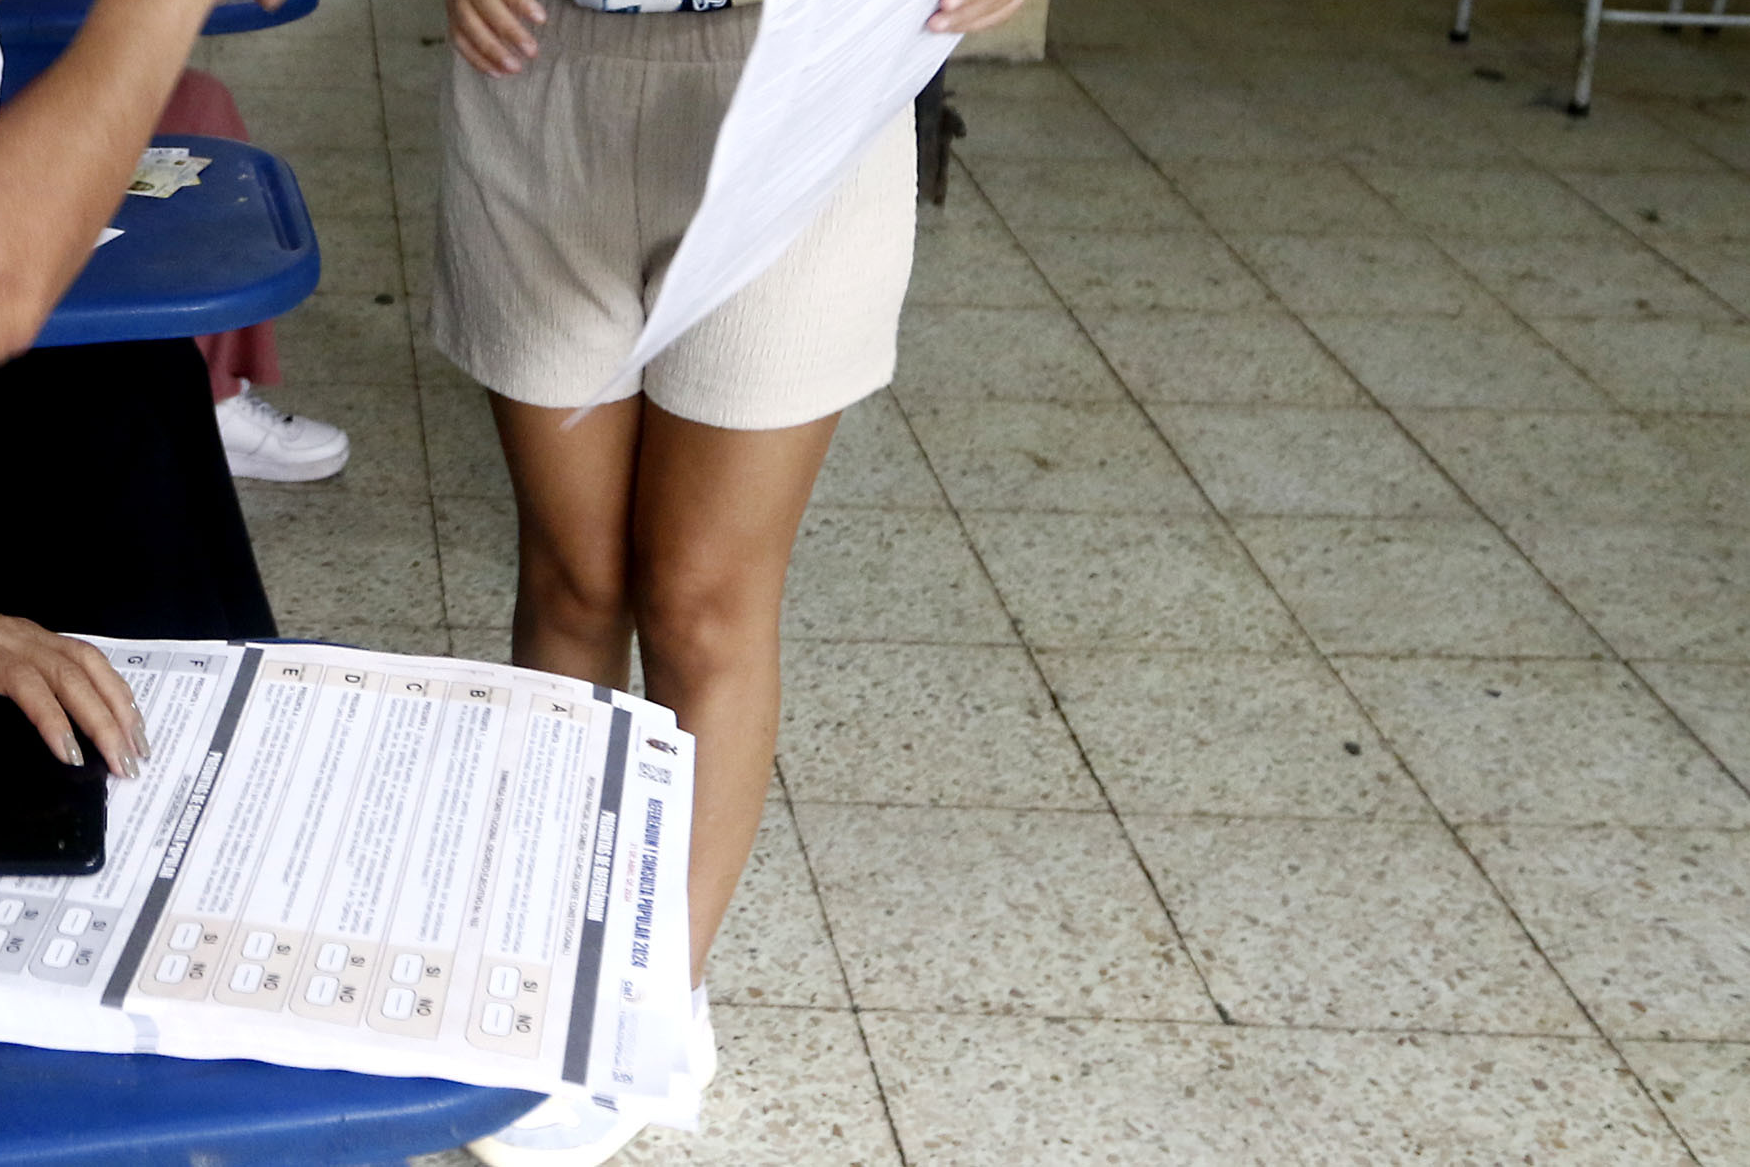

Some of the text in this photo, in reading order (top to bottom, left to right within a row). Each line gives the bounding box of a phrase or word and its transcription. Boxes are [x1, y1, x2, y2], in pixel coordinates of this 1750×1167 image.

[128, 656, 143, 664] G
[189, 659, 204, 667] F
[282, 668, 298, 676] E
[345, 674, 360, 683] D
[406, 683, 422, 692] C
[470, 690, 486, 698] B
[552, 703, 568, 712] A
[194, 750, 224, 796] PREGUNTAS
[189, 793, 206, 806] DE
[644, 798, 664, 848] REFERÉNDUM
[158, 841, 186, 879] POPULAR
[586, 809, 617, 922] PREGUNTAS DE REFERÉNDUM
[639, 854, 659, 896] CONSULTA
[634, 898, 654, 940] POPULAR
[6, 937, 25, 954] NO
[76, 947, 94, 966] NO
[189, 933, 218, 981] SI NO
[631, 941, 650, 969] 2024
[263, 944, 291, 991] SI NO
[339, 956, 366, 1004] SI NO
[416, 966, 442, 1016] SI NO
[515, 980, 538, 1033] SI NO
